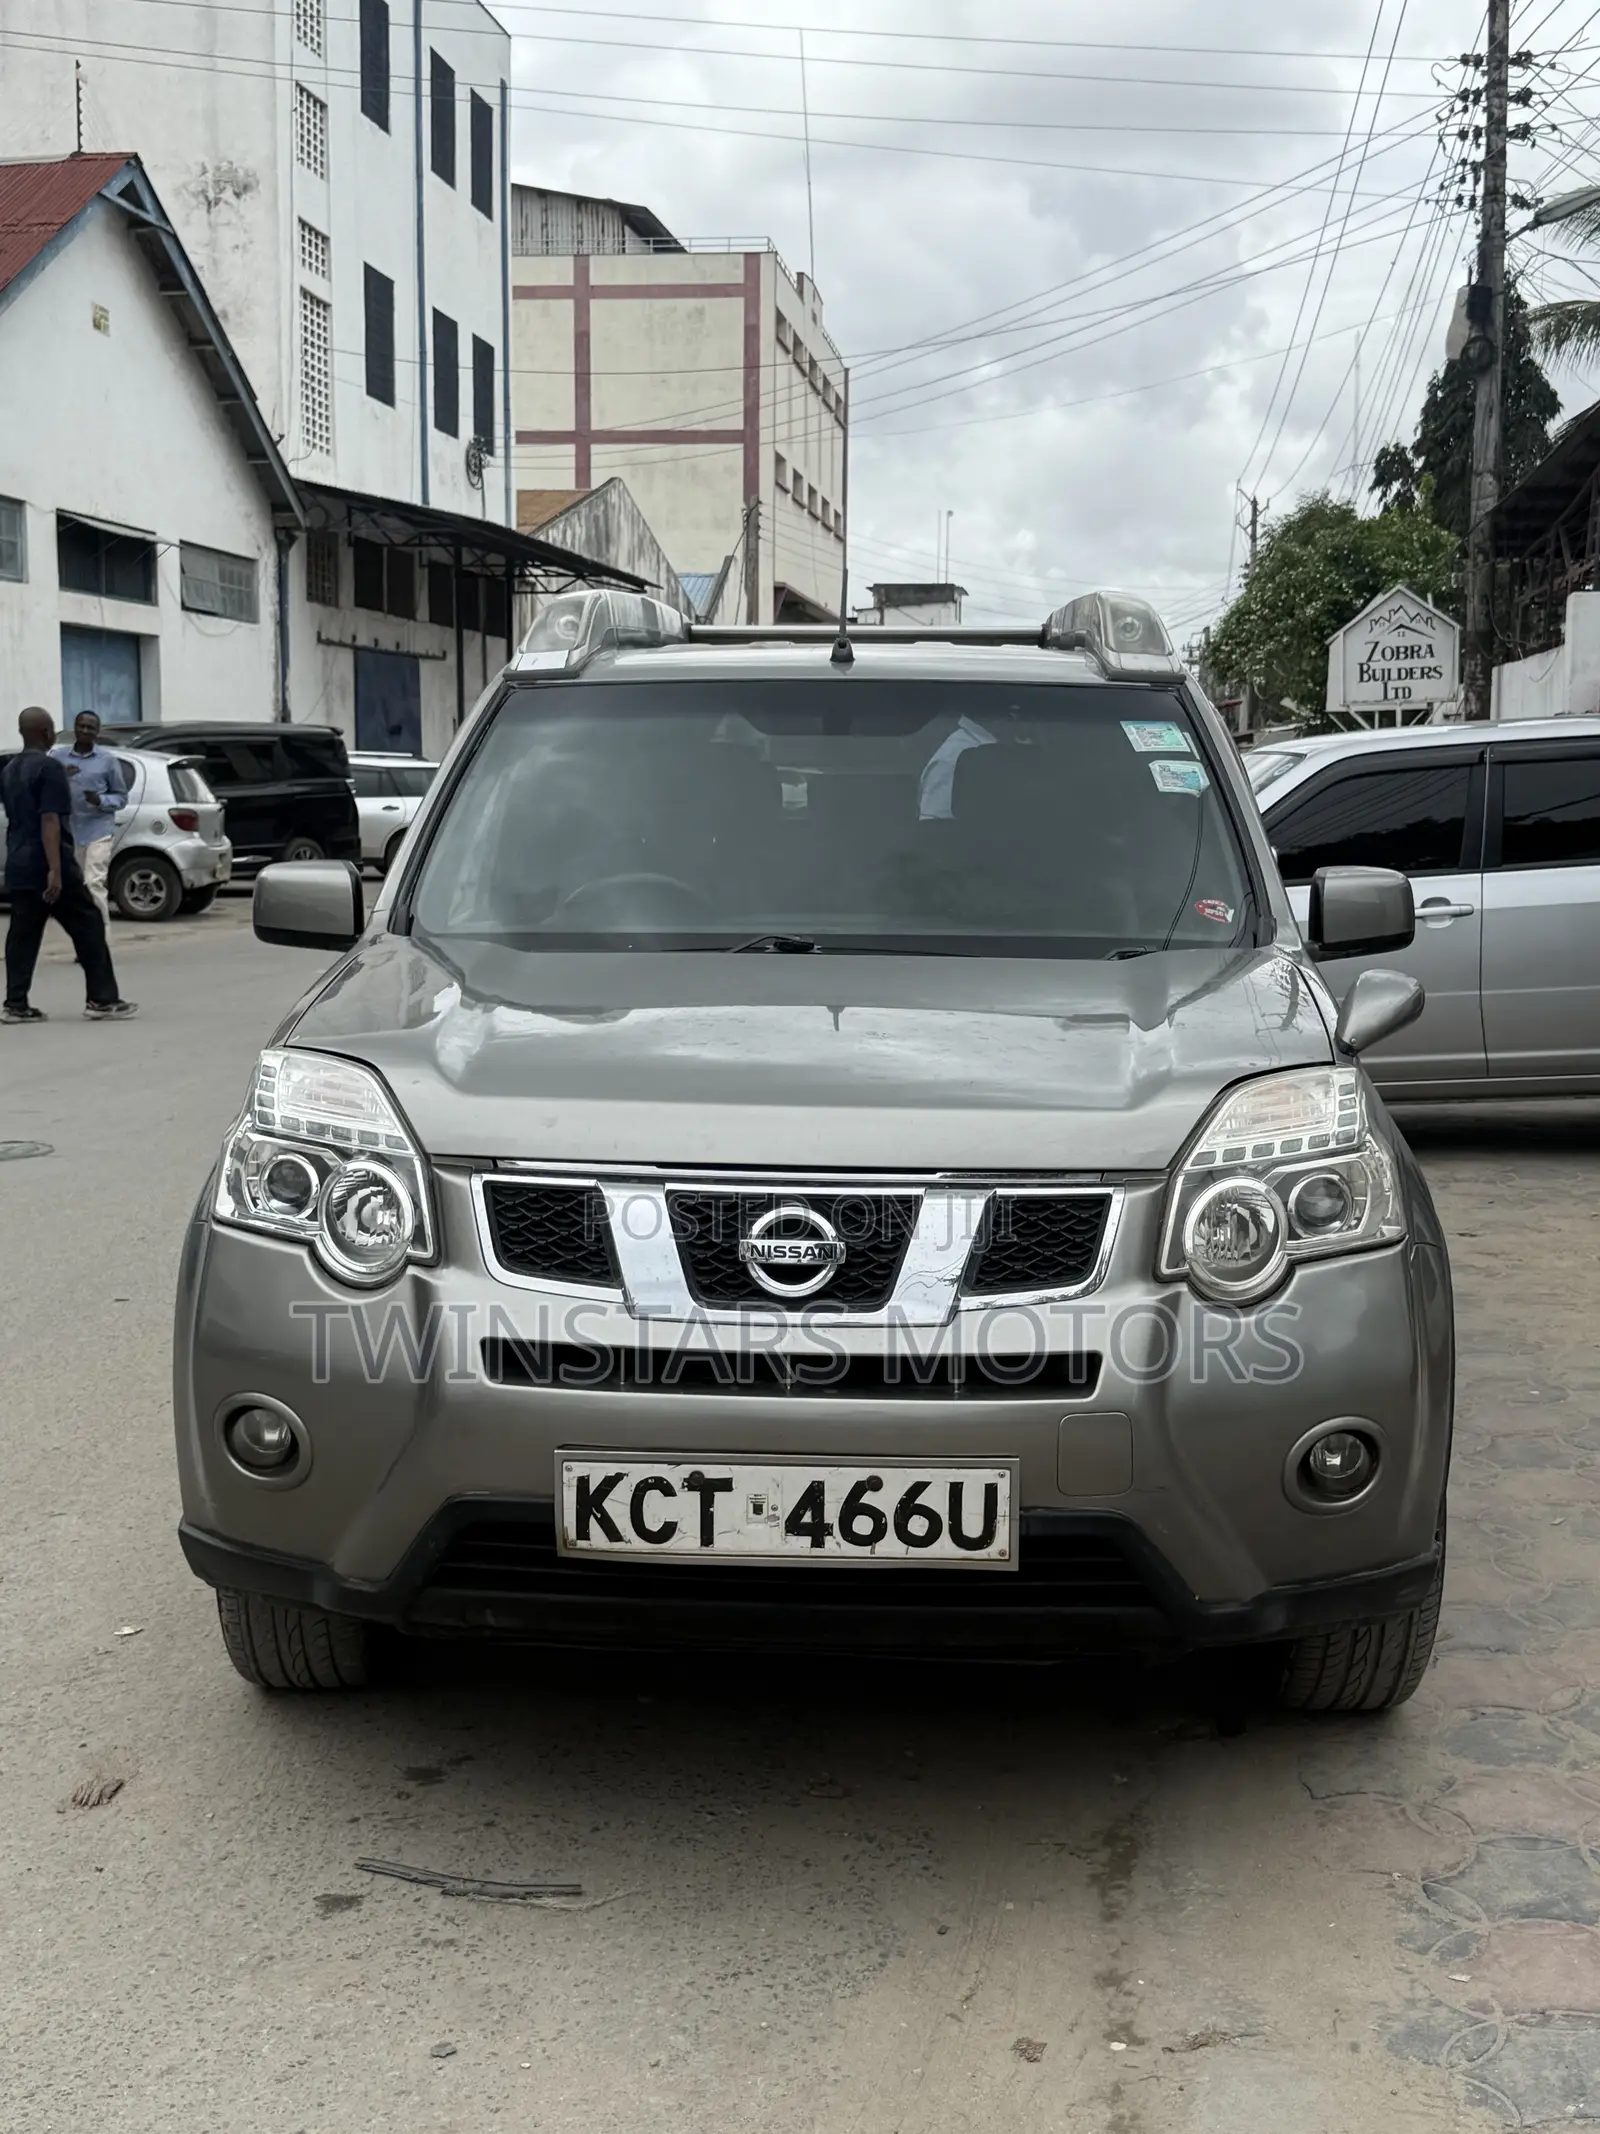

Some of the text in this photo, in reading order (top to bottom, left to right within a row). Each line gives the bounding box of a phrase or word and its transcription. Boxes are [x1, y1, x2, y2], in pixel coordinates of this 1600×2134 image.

[1364, 640, 1435, 663] ZOBRA
[1358, 662, 1443, 683] BUILDERS
[1382, 682, 1412, 700] LTD
[750, 1243, 838, 1260] NISSAN
[575, 1471, 998, 1551] KCT 466U
